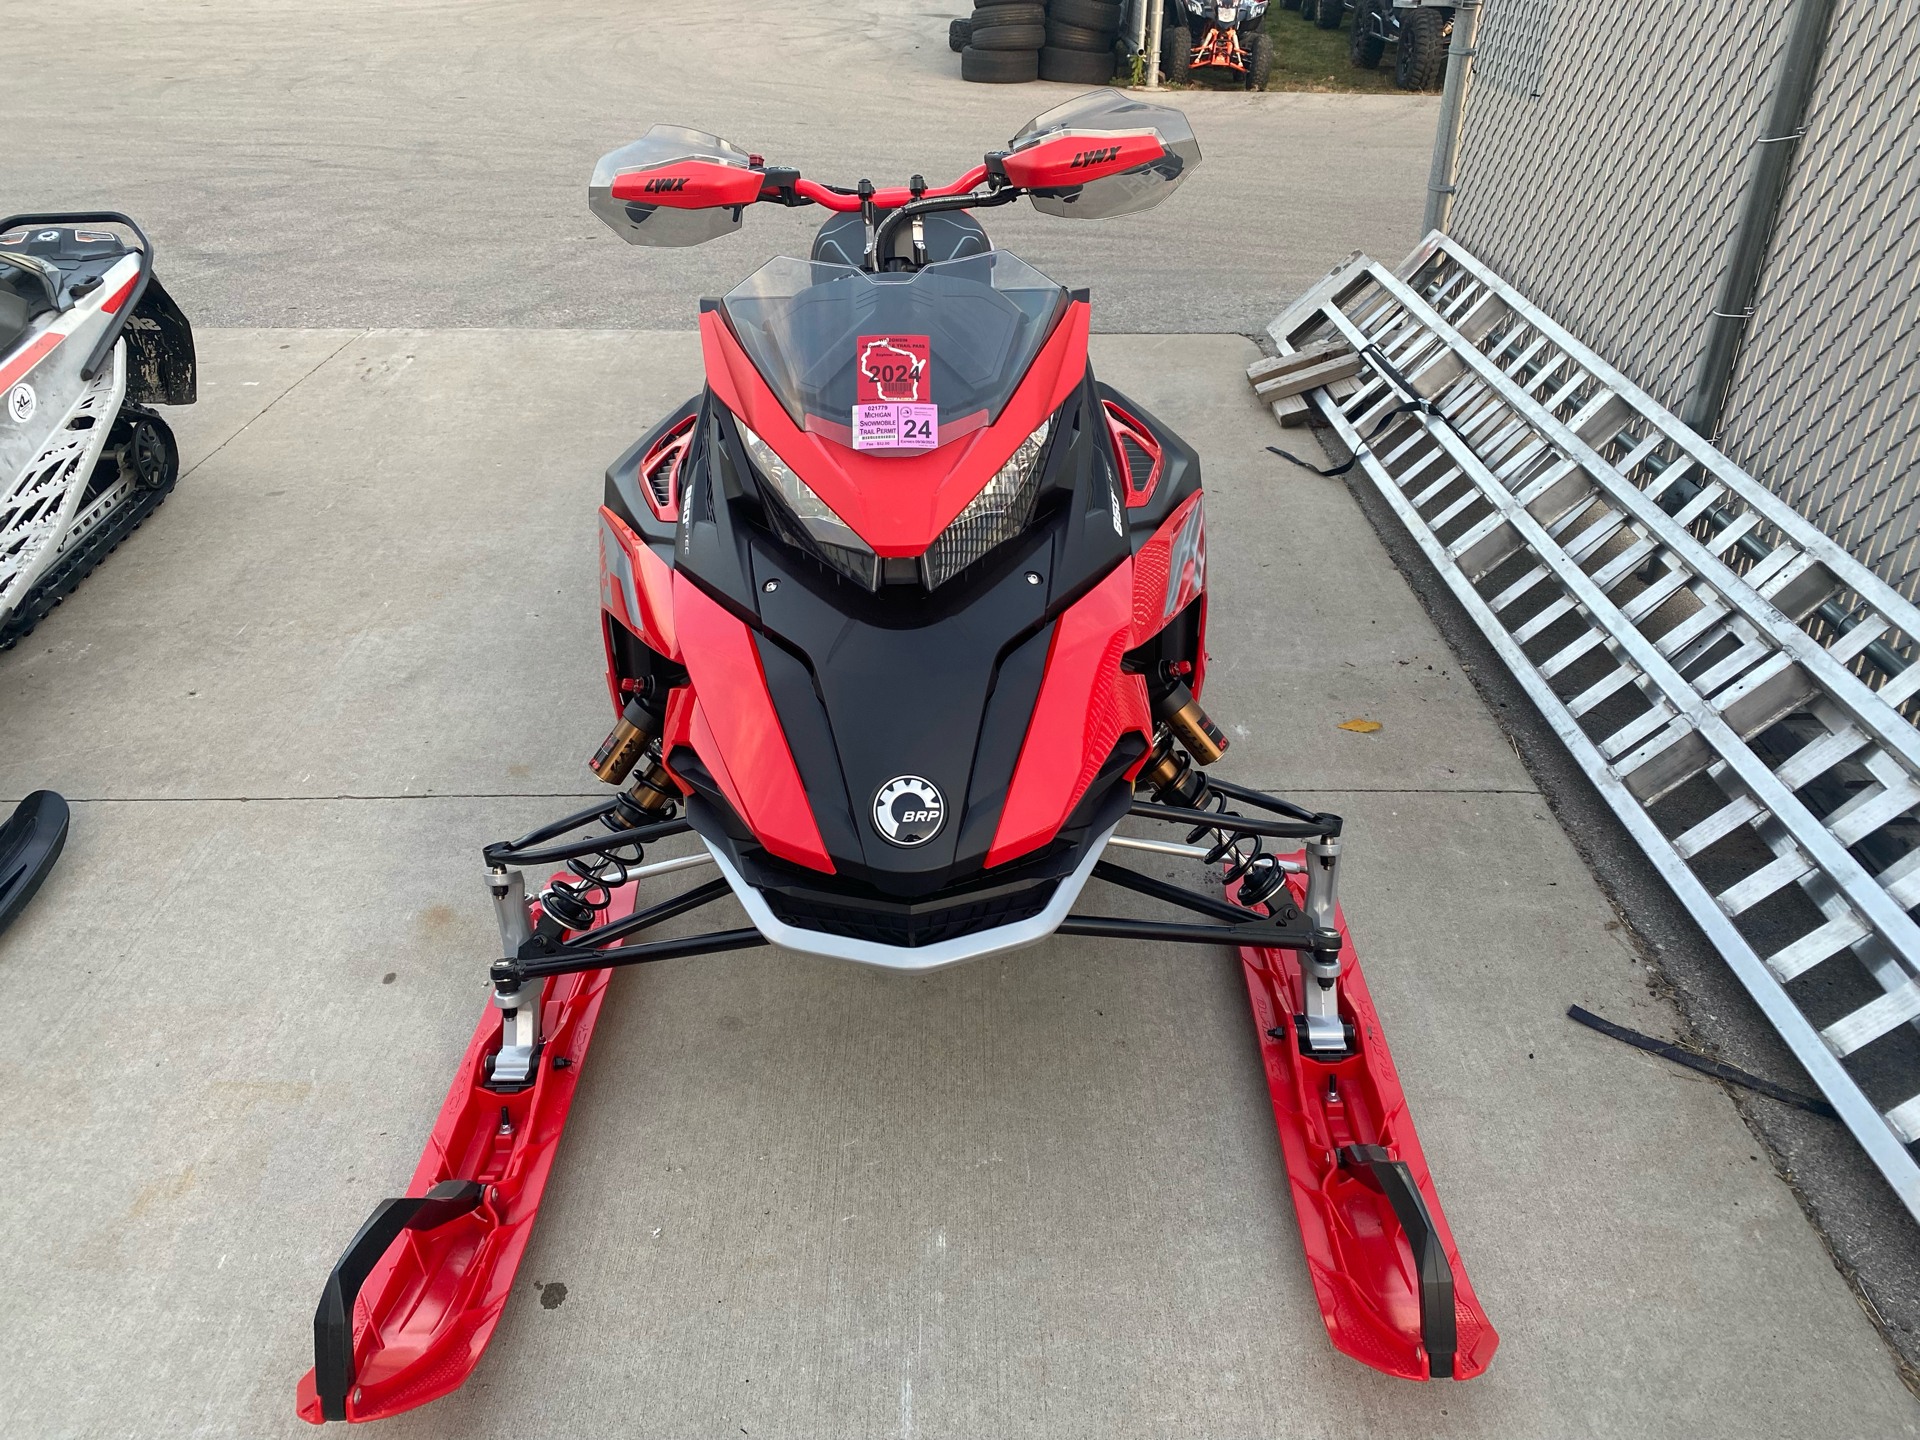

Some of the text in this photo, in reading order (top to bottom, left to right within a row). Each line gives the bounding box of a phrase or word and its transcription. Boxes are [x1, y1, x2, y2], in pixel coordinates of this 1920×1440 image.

[1070, 145, 1122, 169] LYNX
[645, 177, 690, 193] LYNX
[868, 365, 922, 383] 2024
[903, 420, 932, 438] 24
[1110, 492, 1123, 537] 850
[902, 810, 940, 823] BRP
